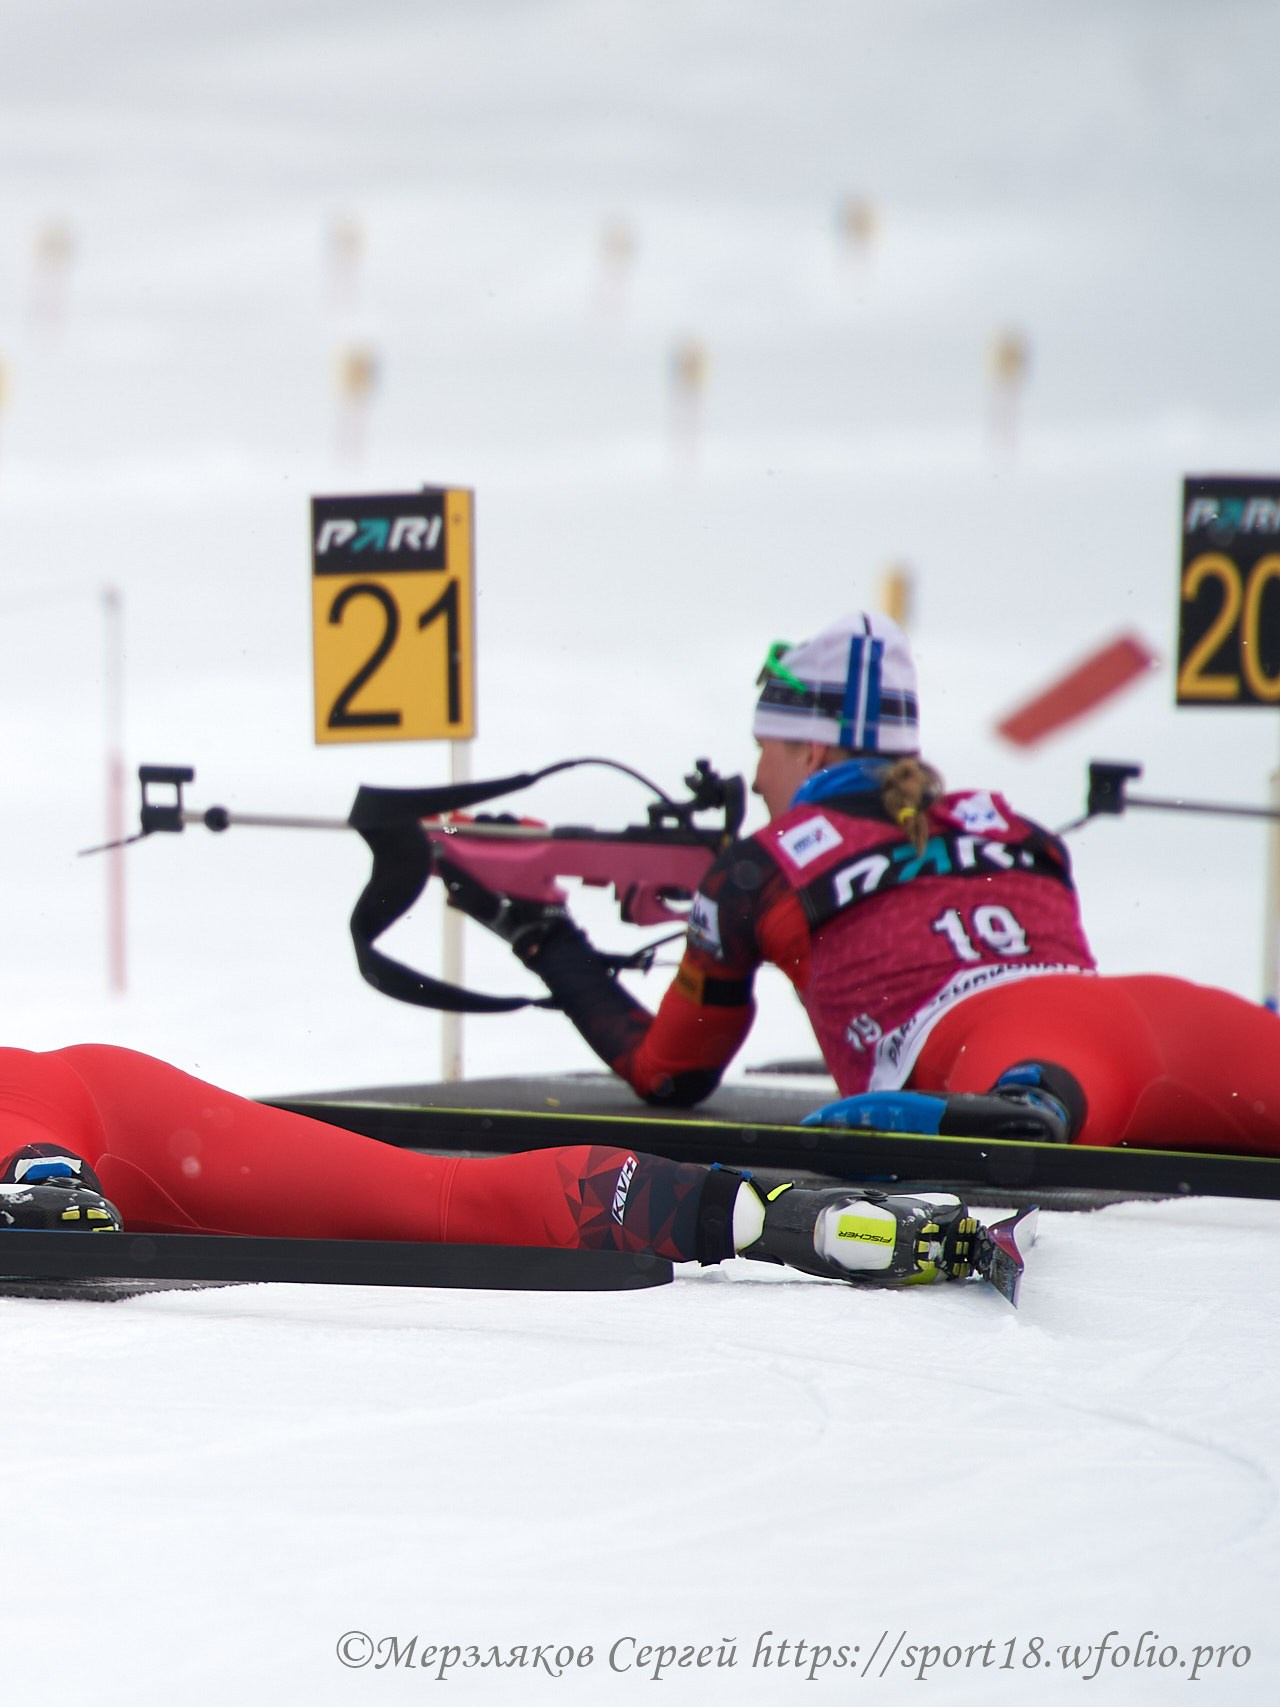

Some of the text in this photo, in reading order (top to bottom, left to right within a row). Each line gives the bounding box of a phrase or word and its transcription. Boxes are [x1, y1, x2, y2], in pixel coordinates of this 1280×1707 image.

[317, 515, 443, 555] PARI
[327, 577, 462, 729] 21
[932, 904, 1031, 962] 19
[845, 1013, 883, 1053] 19
[837, 1230, 894, 1244] FISCHER
